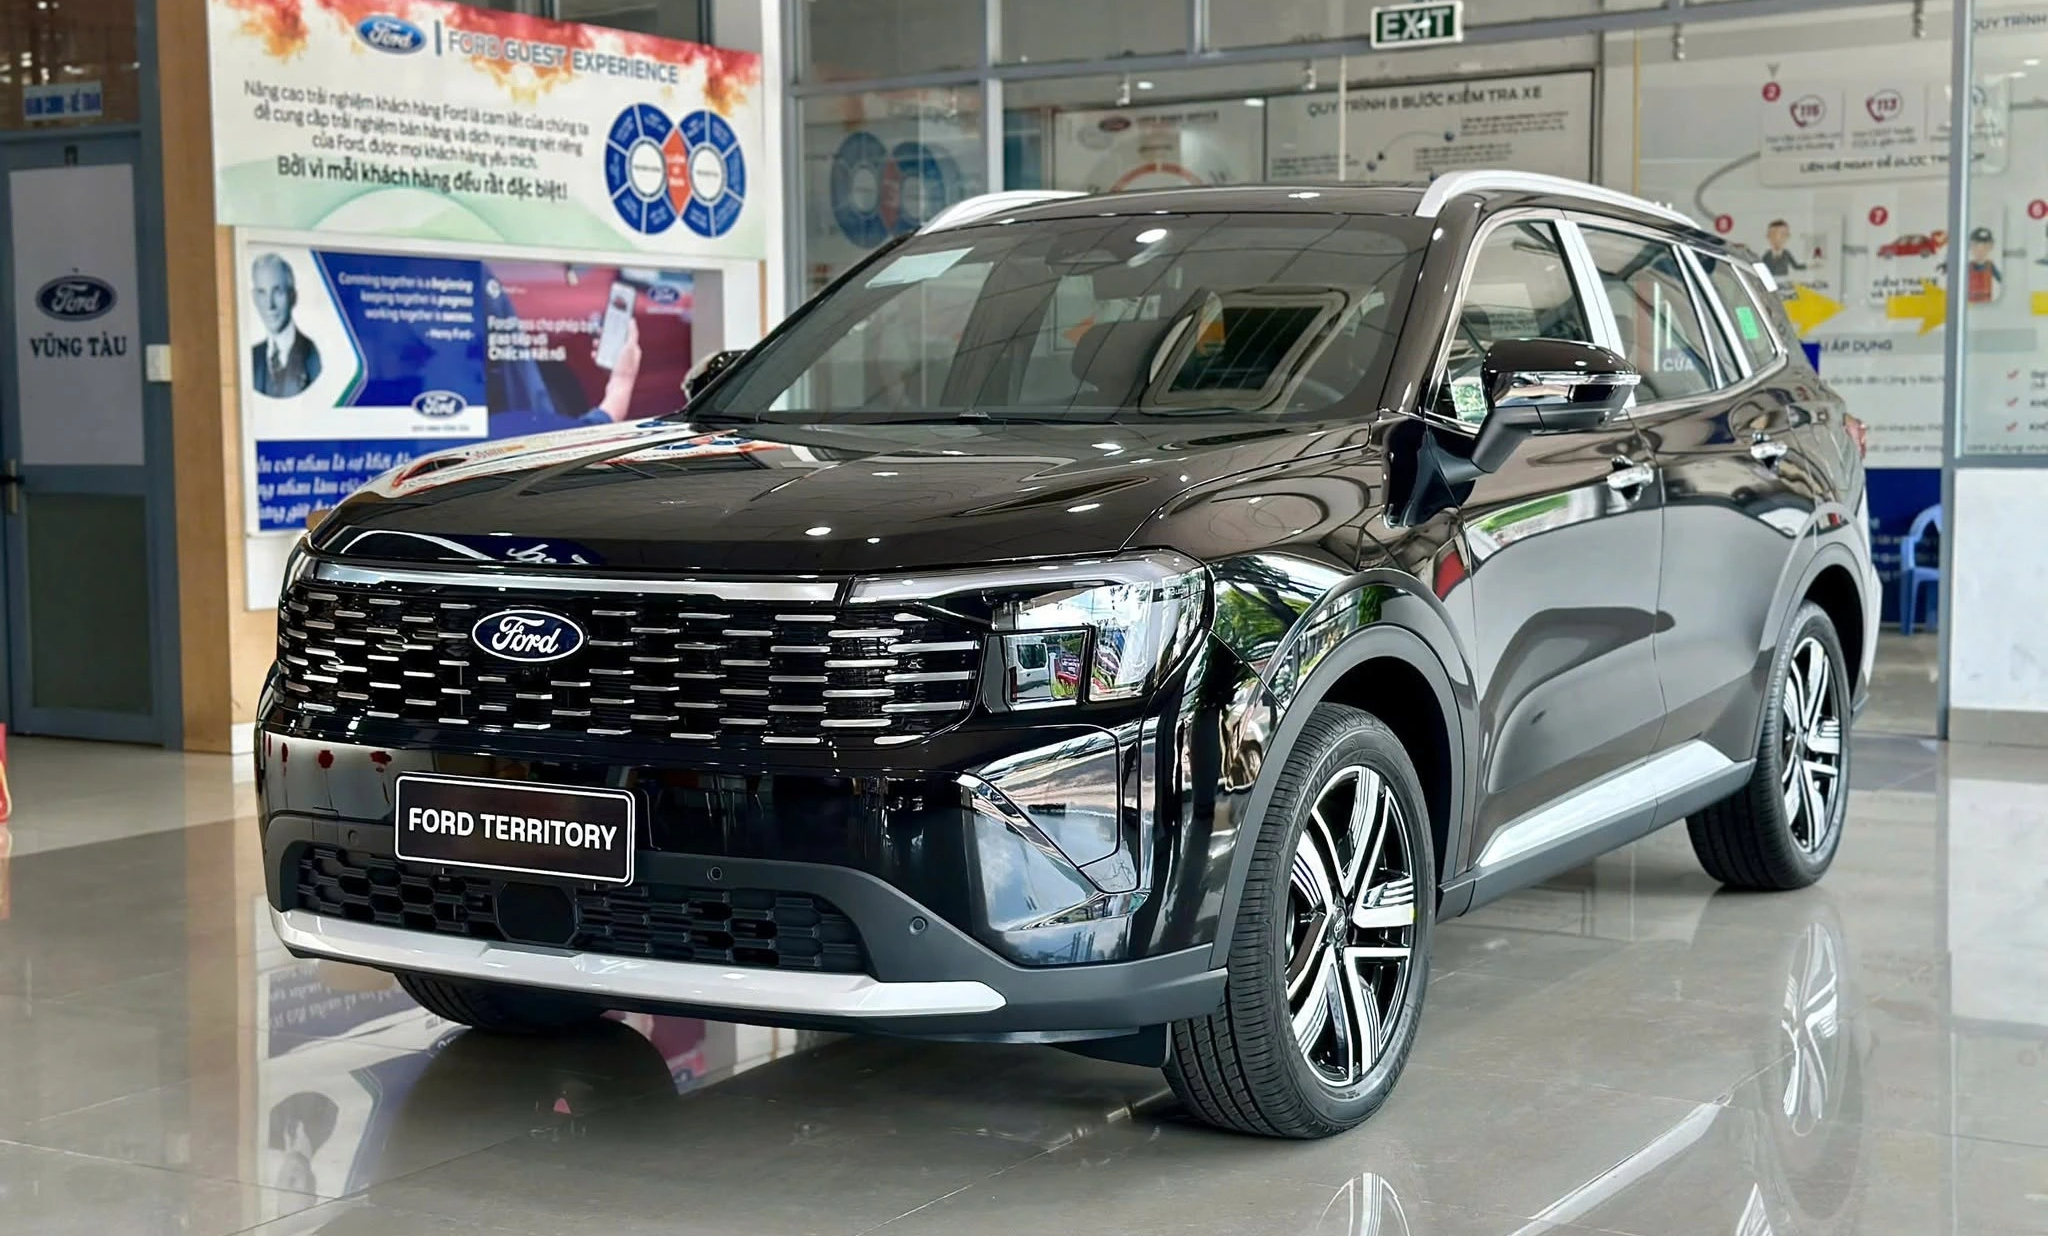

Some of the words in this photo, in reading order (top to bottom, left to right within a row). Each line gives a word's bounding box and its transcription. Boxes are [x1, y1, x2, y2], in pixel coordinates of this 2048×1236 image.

[368, 24, 413, 49] Ford
[1382, 8, 1450, 40] EXIT
[448, 31, 498, 56] FORD
[504, 40, 566, 68] GUEST
[573, 51, 678, 84] EXPERIENCE
[281, 87, 304, 101] cao
[443, 104, 468, 121] Ford
[1487, 88, 1518, 102] TRA
[1522, 86, 1542, 99] XE
[308, 158, 324, 179] vì
[361, 163, 409, 187] khách
[412, 168, 451, 194] hàng
[51, 283, 100, 314] Ford
[29, 332, 84, 358] VŨNG
[90, 333, 127, 357] TÀU
[421, 396, 457, 416] Ford
[491, 615, 562, 654] Ford
[408, 807, 474, 836] FORD
[480, 813, 617, 851] TERRITORY
